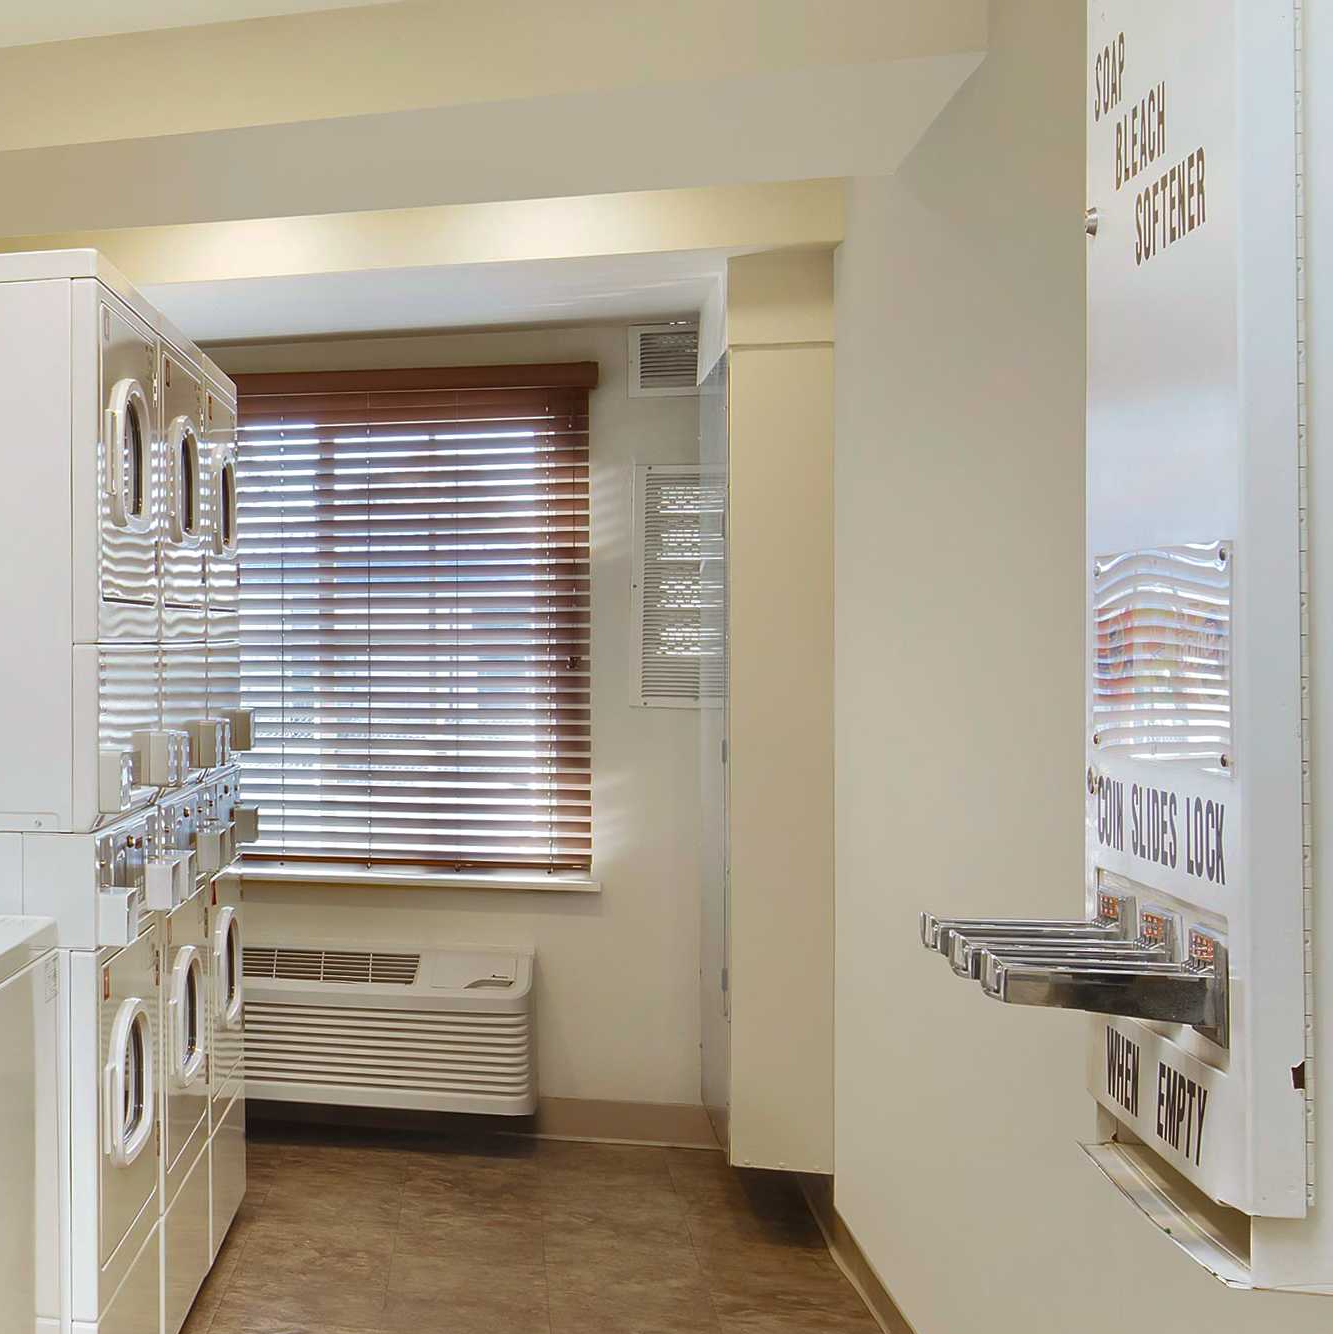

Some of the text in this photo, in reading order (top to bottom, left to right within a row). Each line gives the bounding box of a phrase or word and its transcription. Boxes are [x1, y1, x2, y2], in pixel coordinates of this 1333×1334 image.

[1095, 31, 1125, 122] SOAP
[1115, 80, 1165, 191] BLEACH
[1135, 147, 1206, 266] SOFTENER
[1097, 775, 1226, 886] COIN SLIDES LOCK
[1106, 1025, 1208, 1166] WHEN EMPTY
